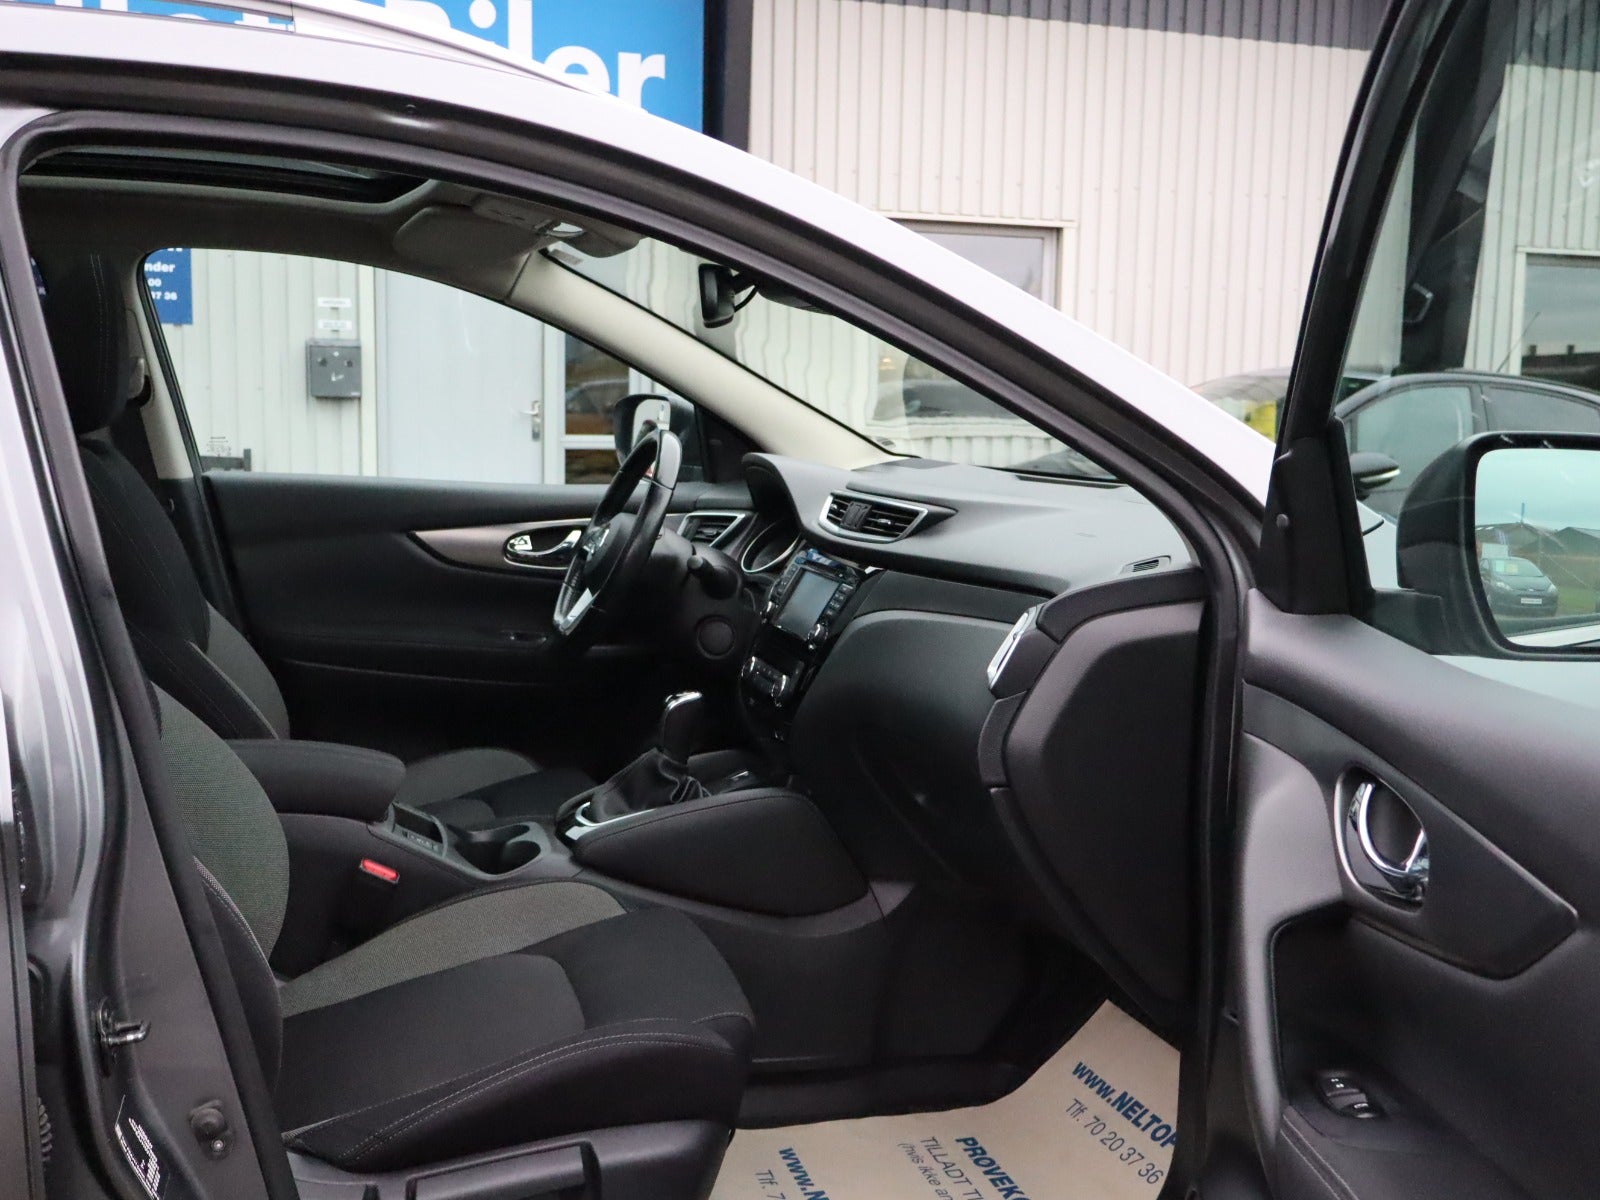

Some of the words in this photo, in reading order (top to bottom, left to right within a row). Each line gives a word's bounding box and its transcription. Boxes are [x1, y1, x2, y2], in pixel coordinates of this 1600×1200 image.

[920, 1136, 973, 1186] TILLADT
[1065, 1098, 1088, 1122] Tlf.
[1084, 1115, 1106, 1136] 70
[1099, 1131, 1125, 1152] 20
[1119, 1147, 1145, 1166] 37
[1137, 1162, 1164, 1185] 36
